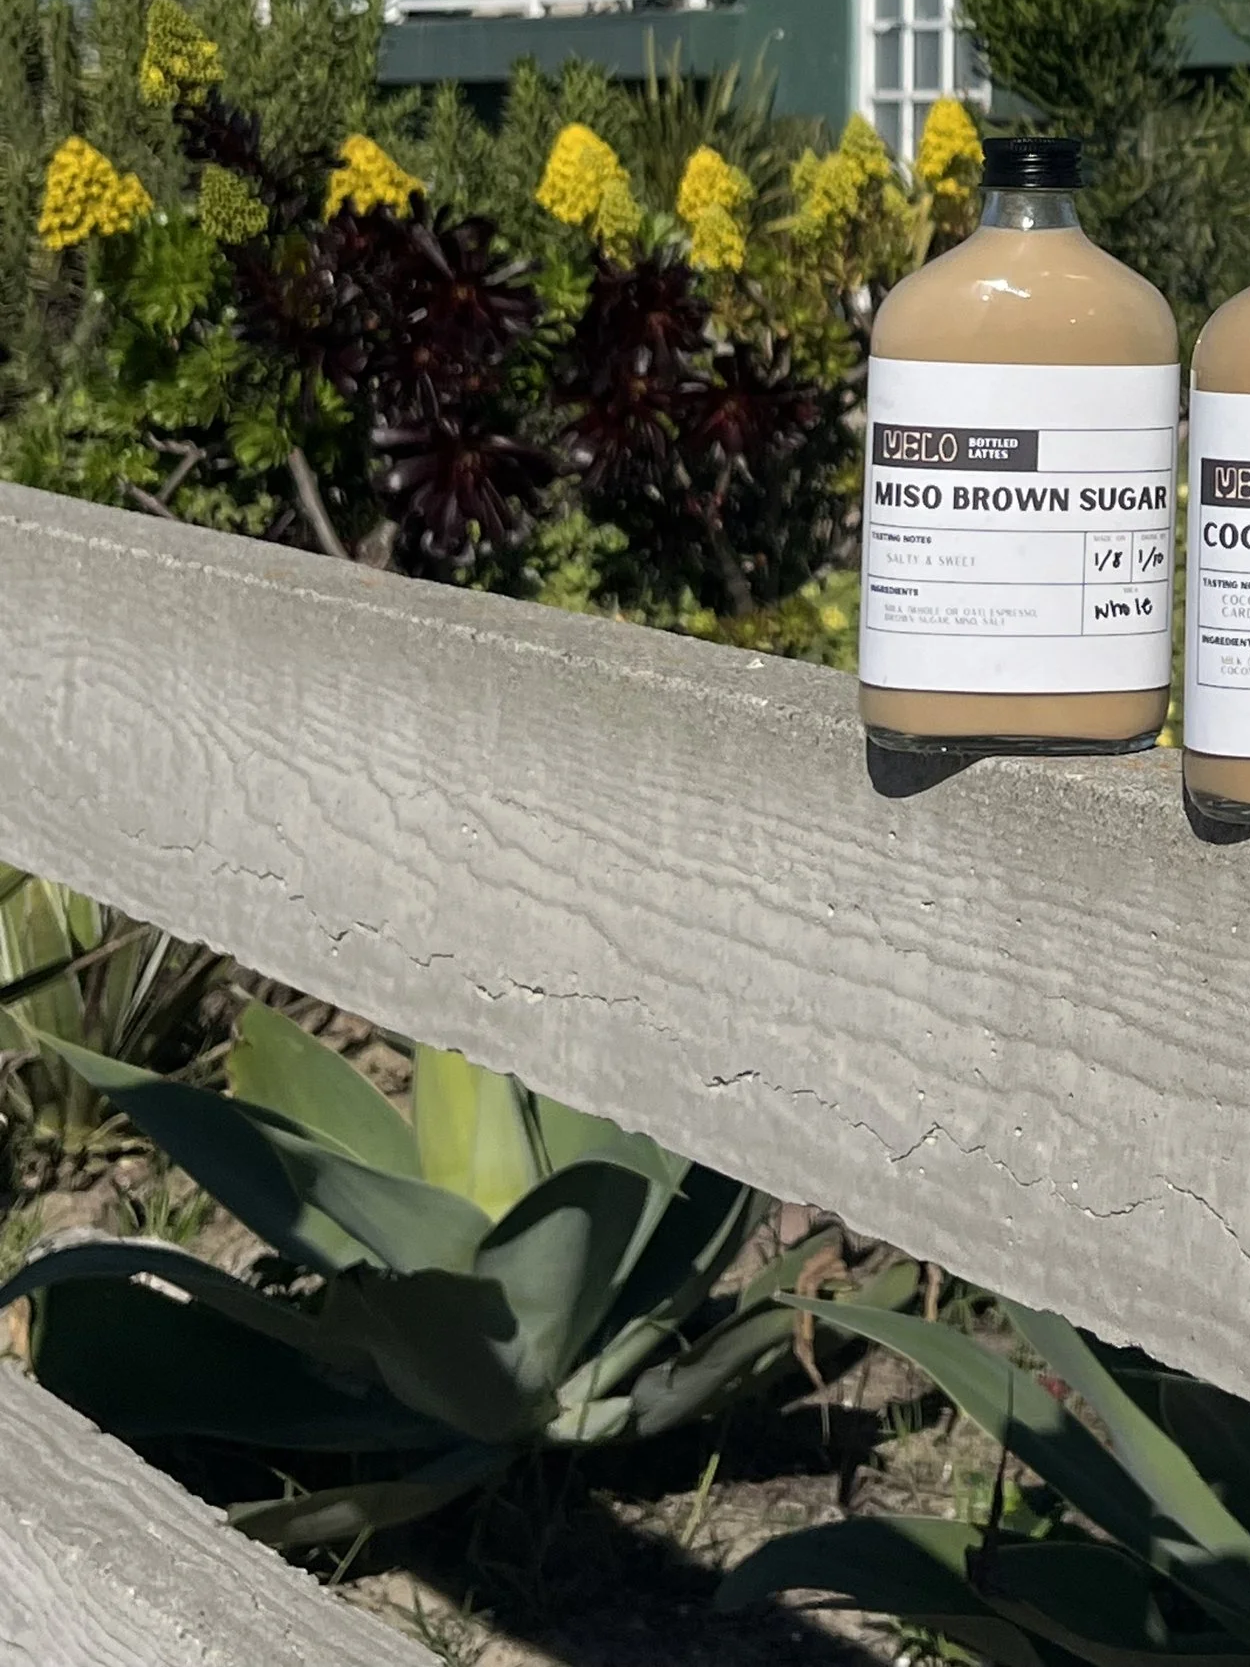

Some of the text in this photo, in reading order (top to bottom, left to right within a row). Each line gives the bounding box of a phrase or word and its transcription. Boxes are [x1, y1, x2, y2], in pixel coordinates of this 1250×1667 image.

[968, 437, 1018, 448] BOTTLED
[968, 449, 1009, 459] LATTES
[875, 481, 1167, 511] MISO BROWN SUGAR
[903, 535, 932, 544] NOTES
[887, 553, 918, 564] SALTY
[939, 556, 975, 566] SWEET
[1095, 549, 1123, 571] 1/8
[1202, 577, 1238, 589] TASTING
